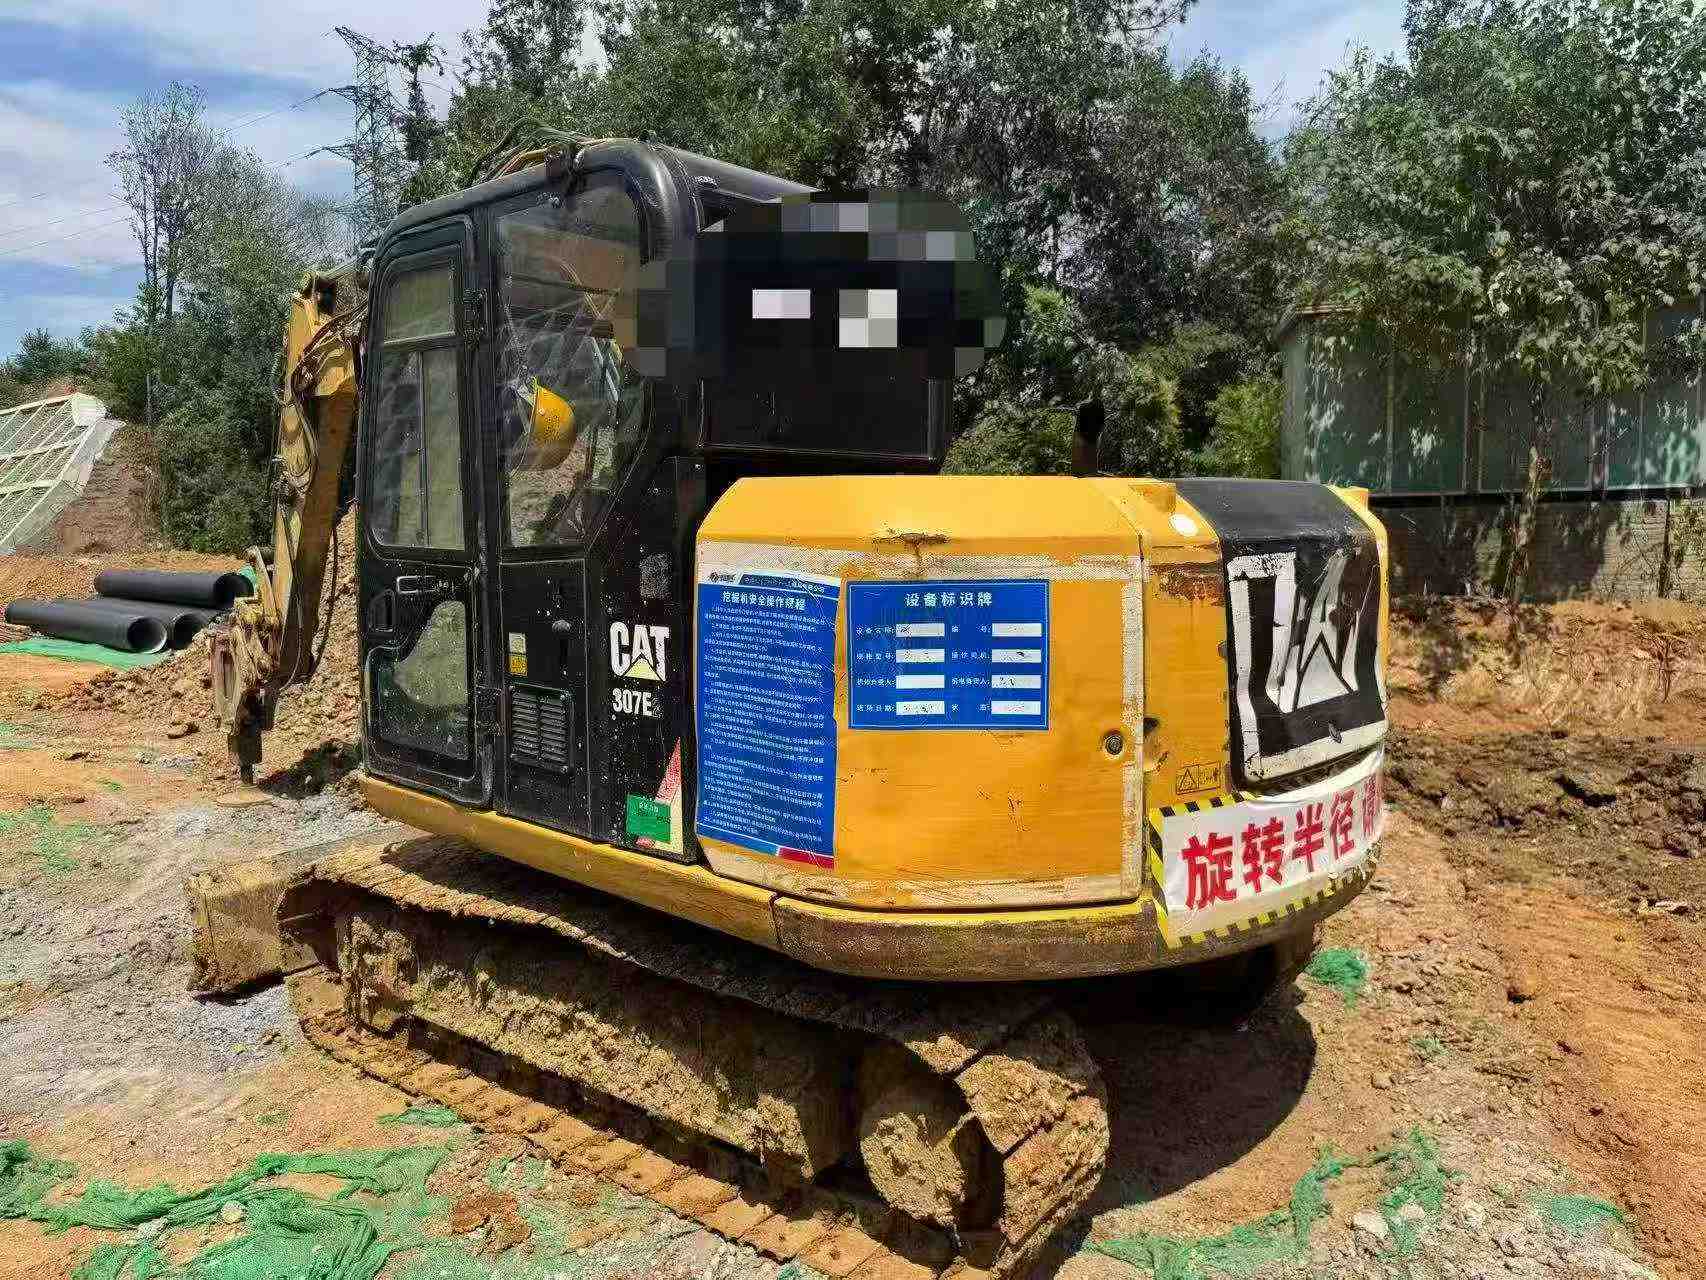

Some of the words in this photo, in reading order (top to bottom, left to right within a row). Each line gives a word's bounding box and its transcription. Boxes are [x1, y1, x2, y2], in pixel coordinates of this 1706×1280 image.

[904, 591, 993, 607] 设备标识牌
[610, 621, 670, 681] CAT
